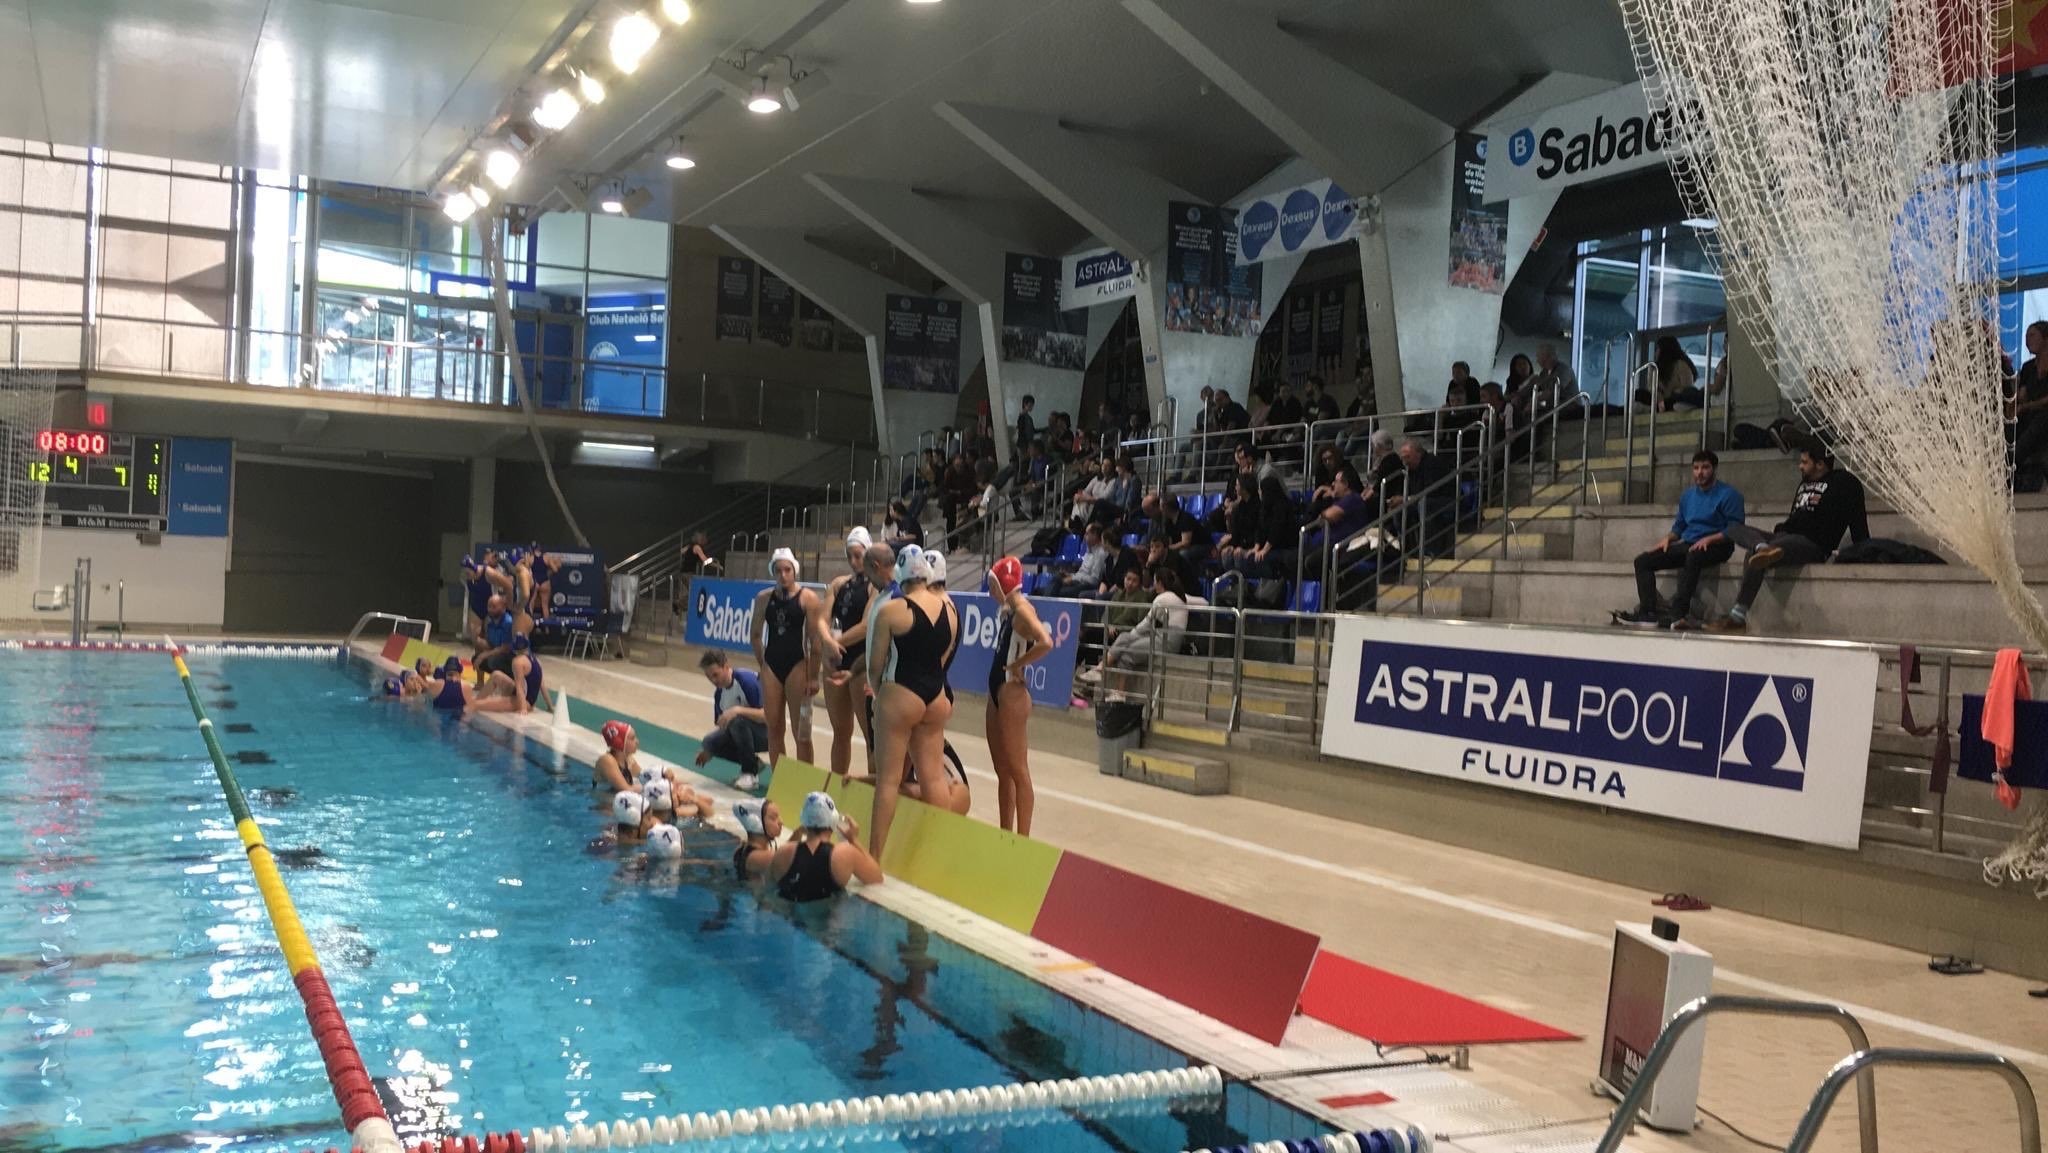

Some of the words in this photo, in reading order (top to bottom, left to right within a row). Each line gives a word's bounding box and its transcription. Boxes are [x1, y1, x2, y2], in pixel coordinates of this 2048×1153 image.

[1281, 208, 1314, 226] Dexeus
[1243, 220, 1273, 235] Dexeus
[589, 315, 610, 325] Club
[40, 432, 105, 454] 08:00
[29, 462, 51, 482] 12
[65, 455, 78, 475] 4
[114, 467, 126, 487] 7
[182, 503, 222, 513] Sabadell
[77, 516, 106, 527] M&M
[1005, 561, 1013, 574] 1
[1365, 662, 1704, 751] ASTRALPOOL
[1461, 747, 1628, 799] FLUIDRA
[662, 831, 673, 844] 7
